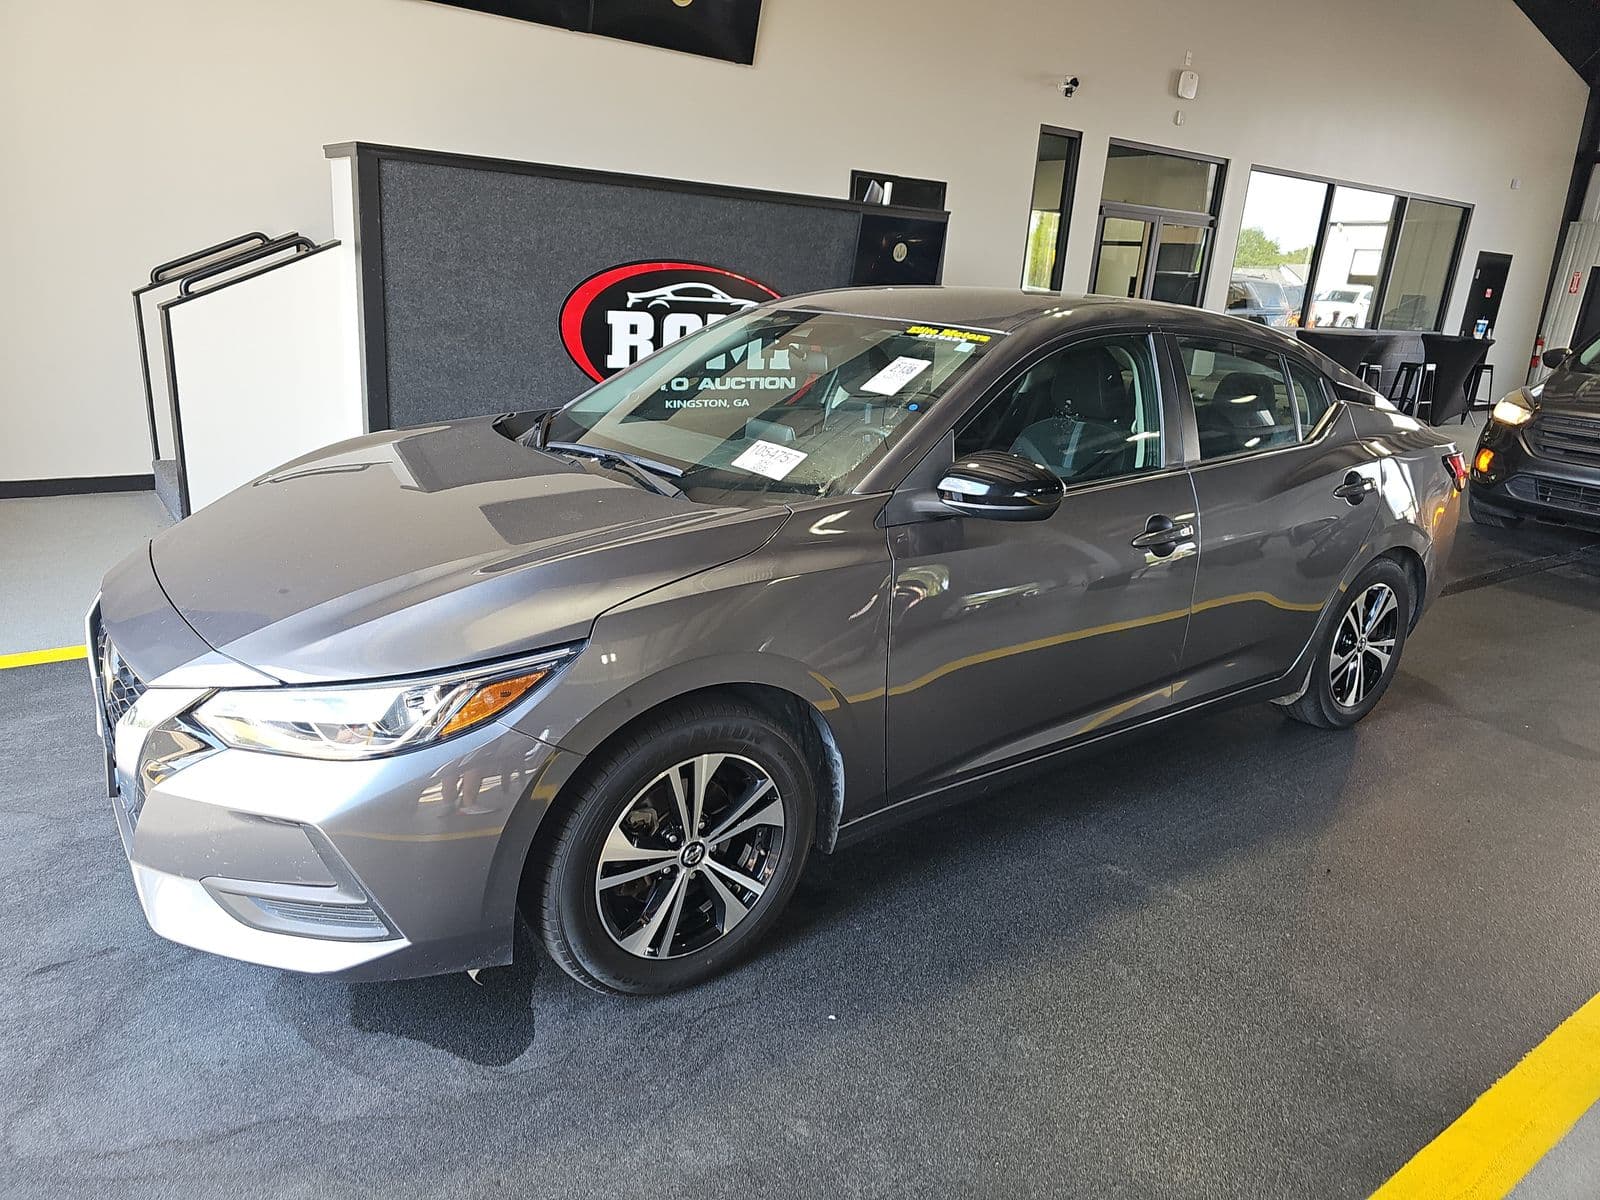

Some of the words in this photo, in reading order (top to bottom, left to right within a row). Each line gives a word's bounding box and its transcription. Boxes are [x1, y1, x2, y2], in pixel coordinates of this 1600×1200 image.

[940, 329, 991, 342] Motors
[698, 377, 796, 391] AUCTION
[665, 400, 730, 410] KINGSTON,
[733, 400, 750, 408] GA
